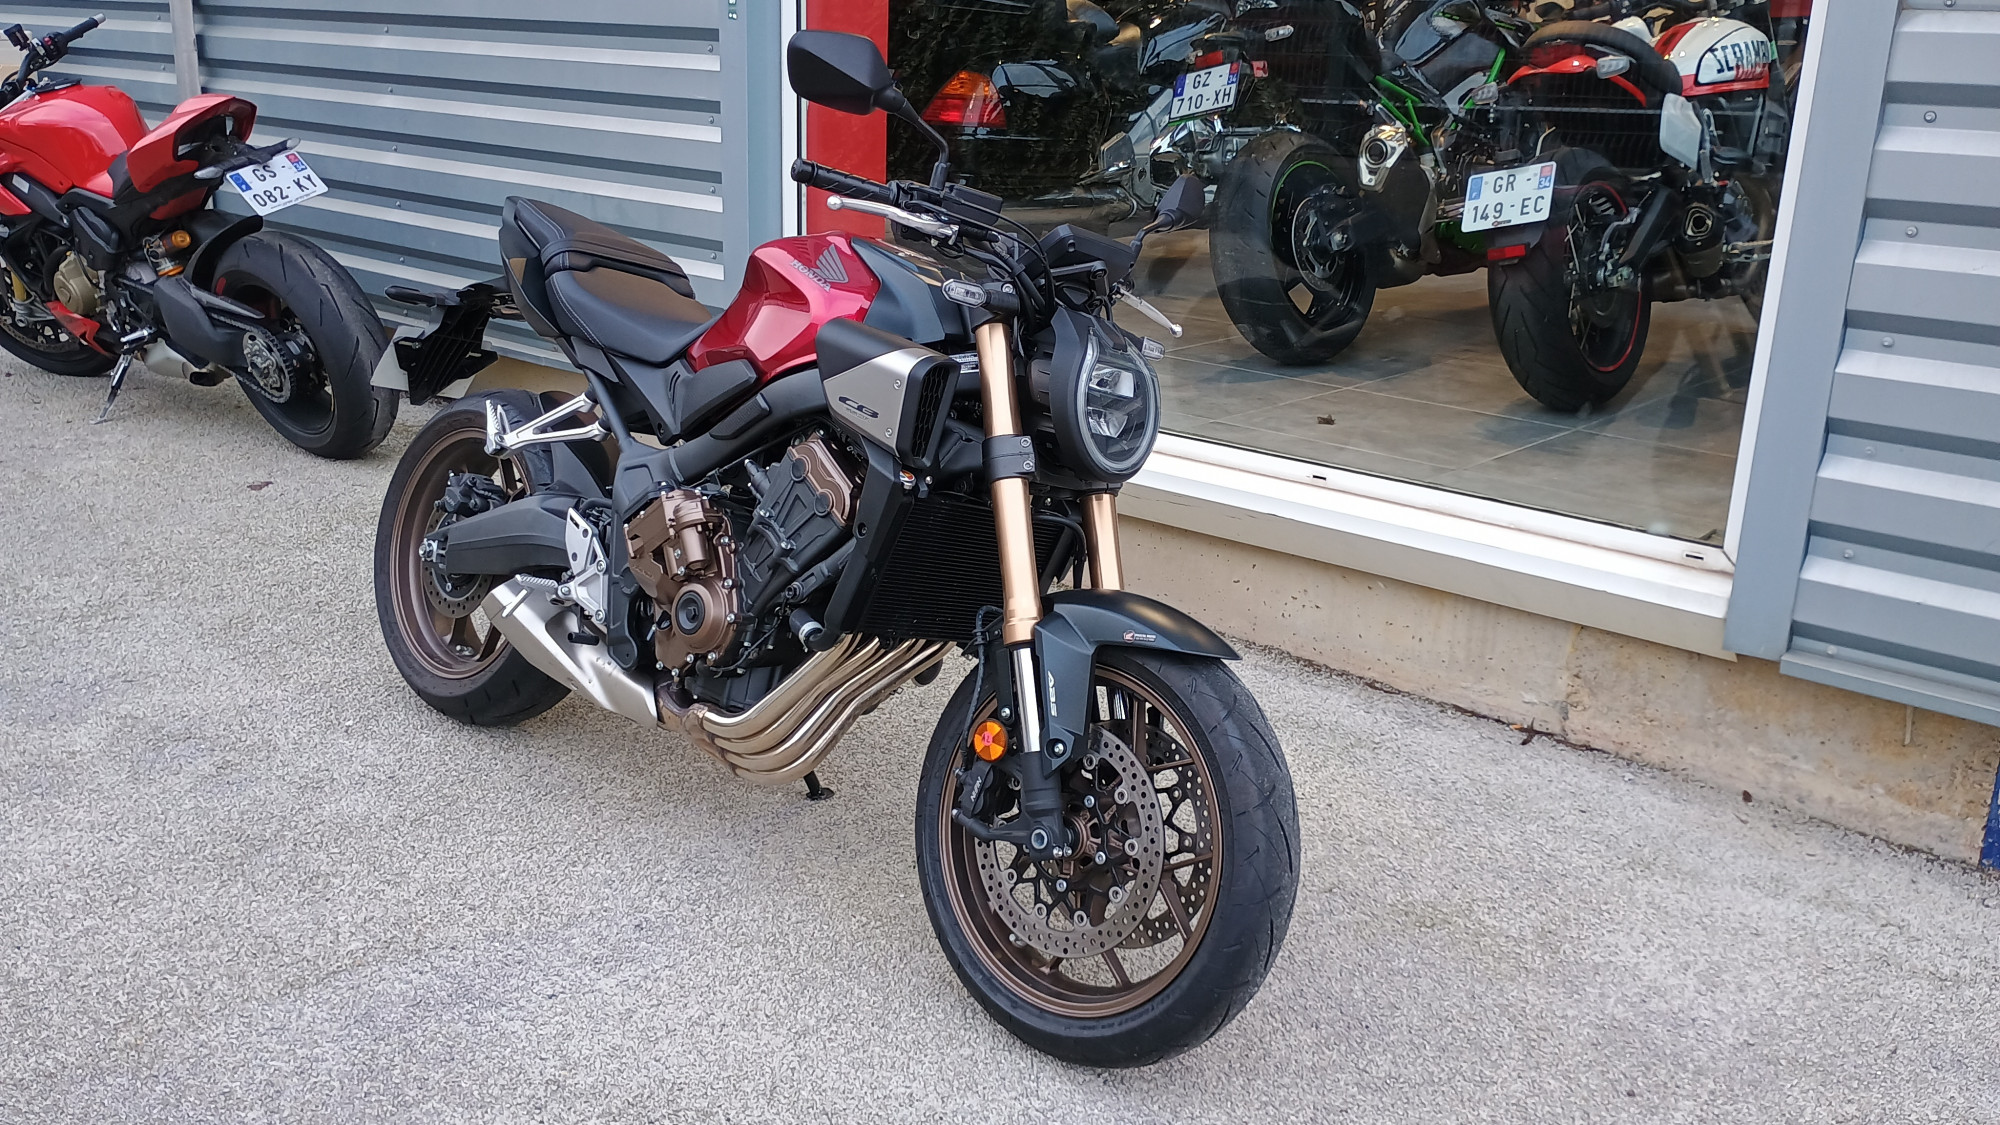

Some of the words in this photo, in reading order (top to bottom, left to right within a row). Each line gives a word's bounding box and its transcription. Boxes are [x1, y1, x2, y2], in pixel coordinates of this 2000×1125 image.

[1193, 71, 1212, 90] GZ
[1229, 75, 1237, 84] 34
[252, 164, 277, 182] GS
[1539, 177, 1551, 188] 34
[1493, 174, 1516, 194] GR
[790, 259, 831, 292] HONDA
[838, 396, 879, 418] CB
[1047, 670, 1057, 717] ABS
